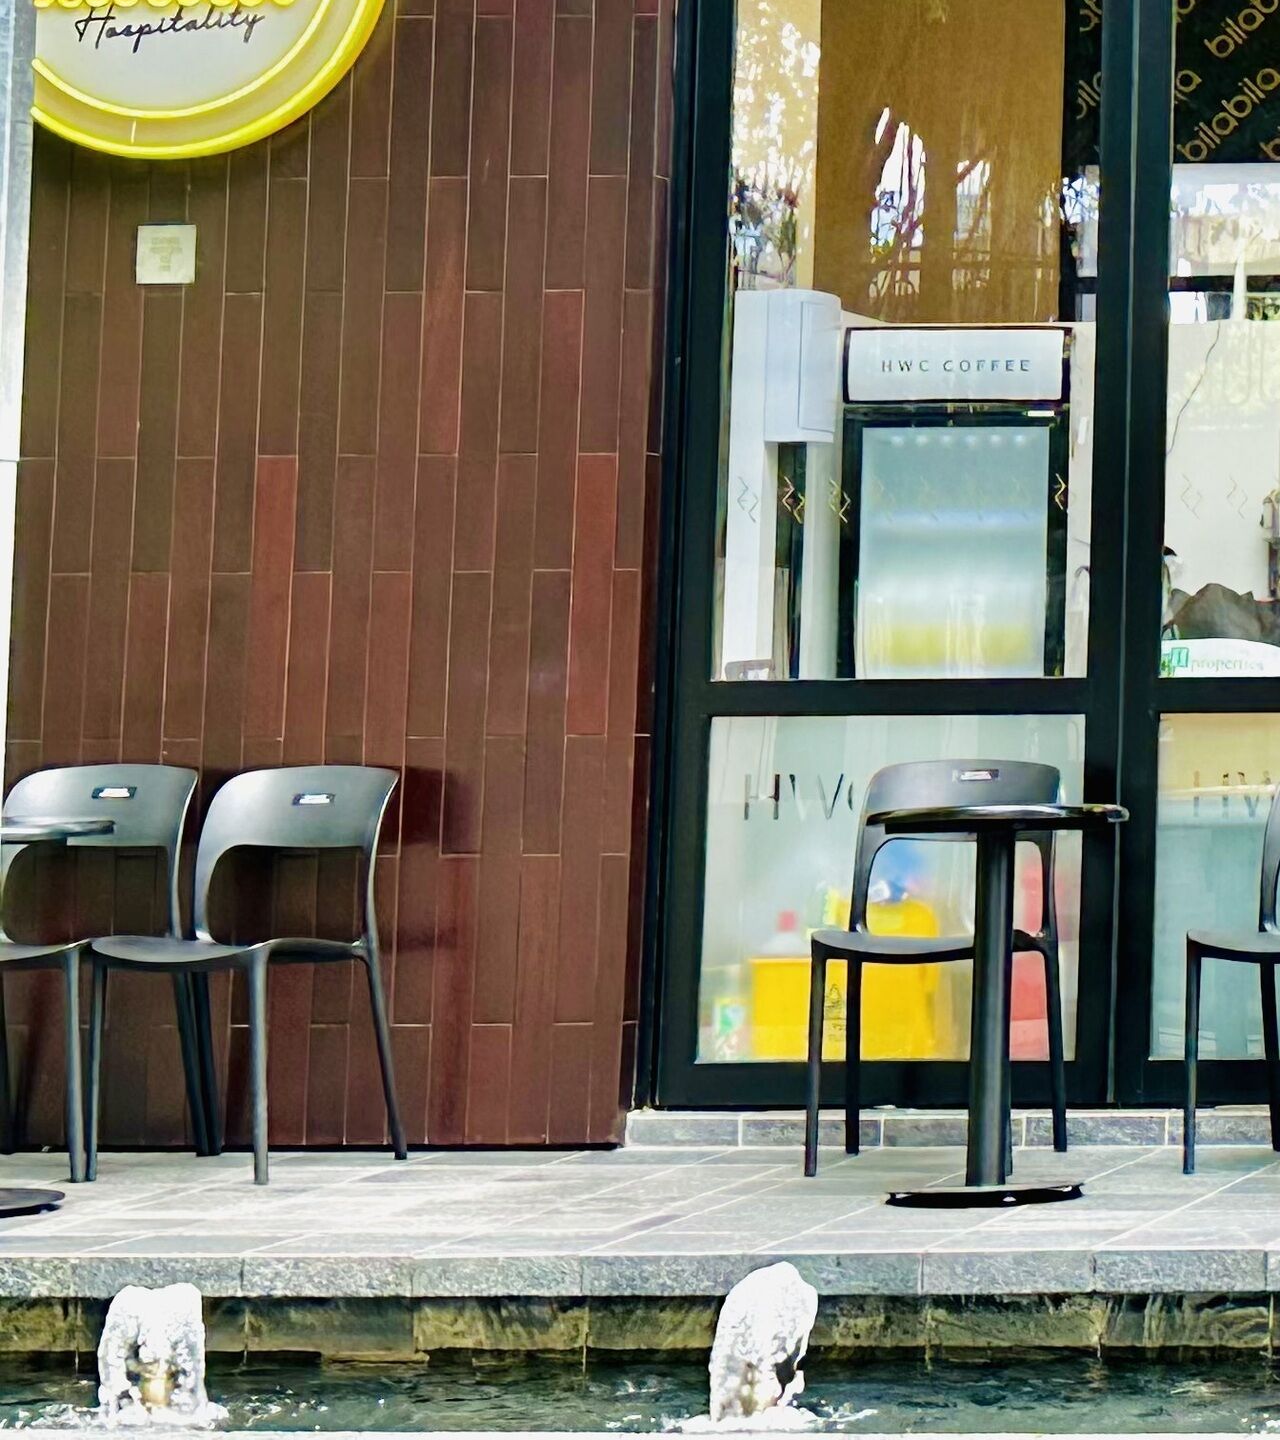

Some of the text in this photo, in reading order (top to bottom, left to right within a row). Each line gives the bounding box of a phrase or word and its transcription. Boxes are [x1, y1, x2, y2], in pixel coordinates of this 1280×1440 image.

[75, 4, 265, 53] Hospitality
[881, 359, 1032, 374] HWC COFFEE
